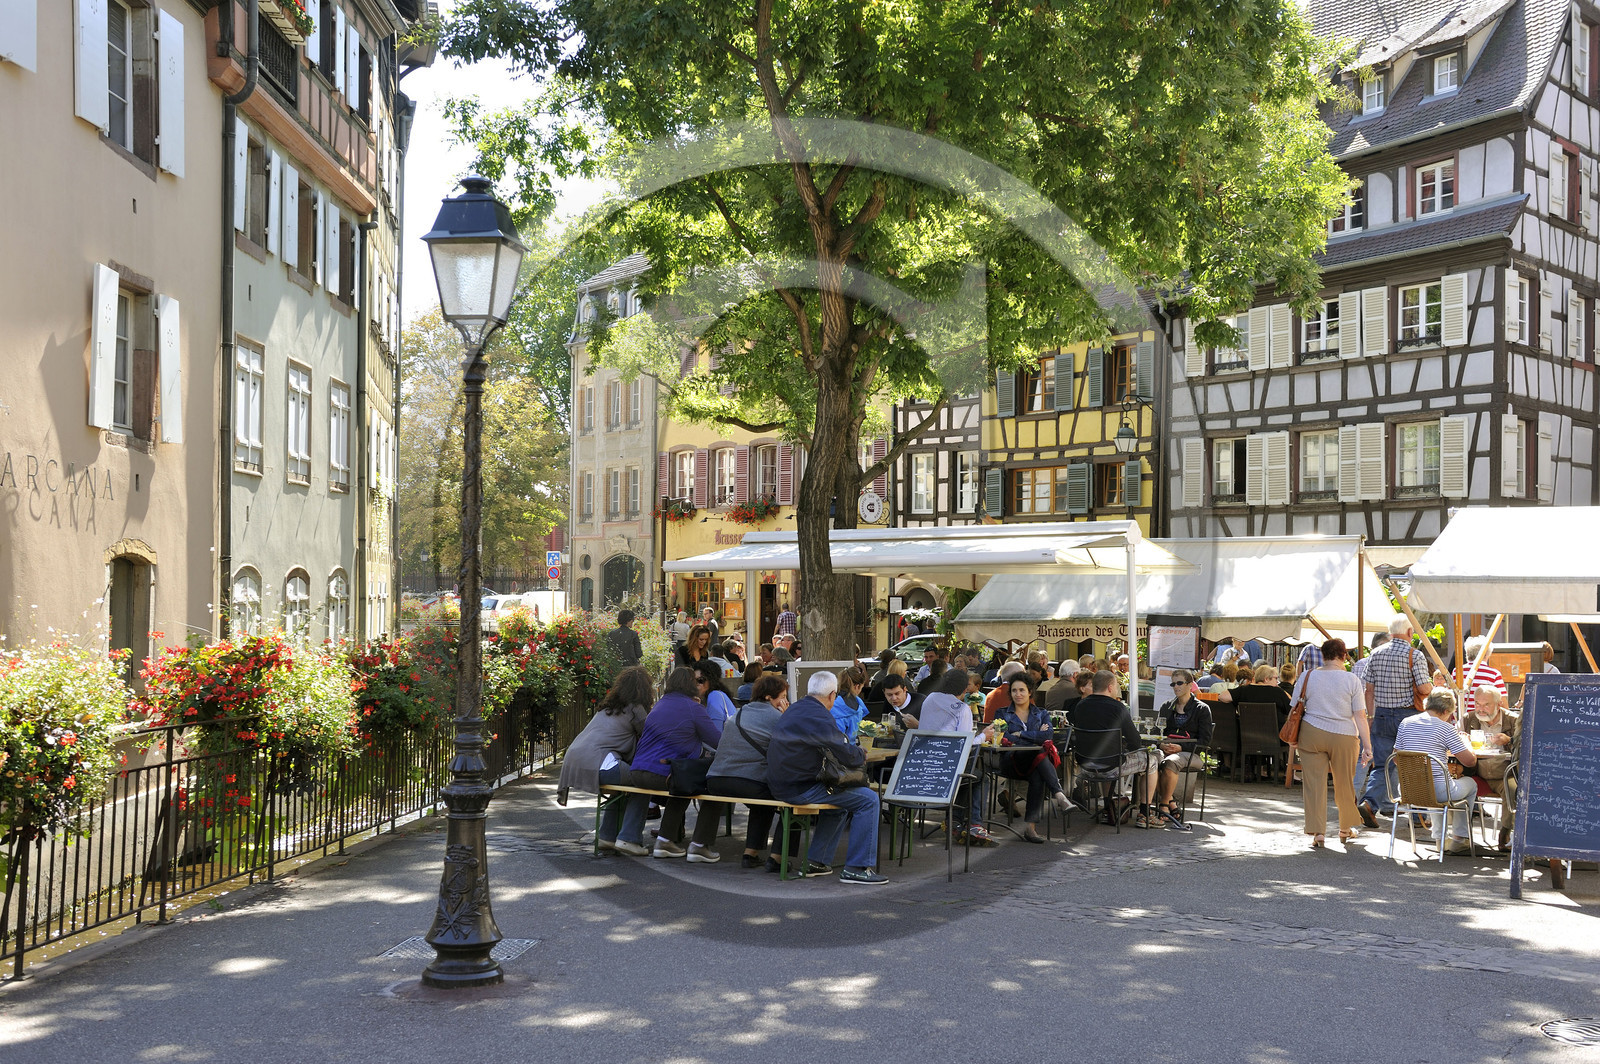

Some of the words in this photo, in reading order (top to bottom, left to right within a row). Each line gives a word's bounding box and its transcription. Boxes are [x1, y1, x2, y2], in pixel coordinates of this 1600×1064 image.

[0, 452, 114, 501] ARCANA
[714, 528, 745, 545] Brasse
[1037, 624, 1090, 638] Brasserie
[1095, 625, 1114, 637] des
[1572, 684, 1600, 692] Musa
